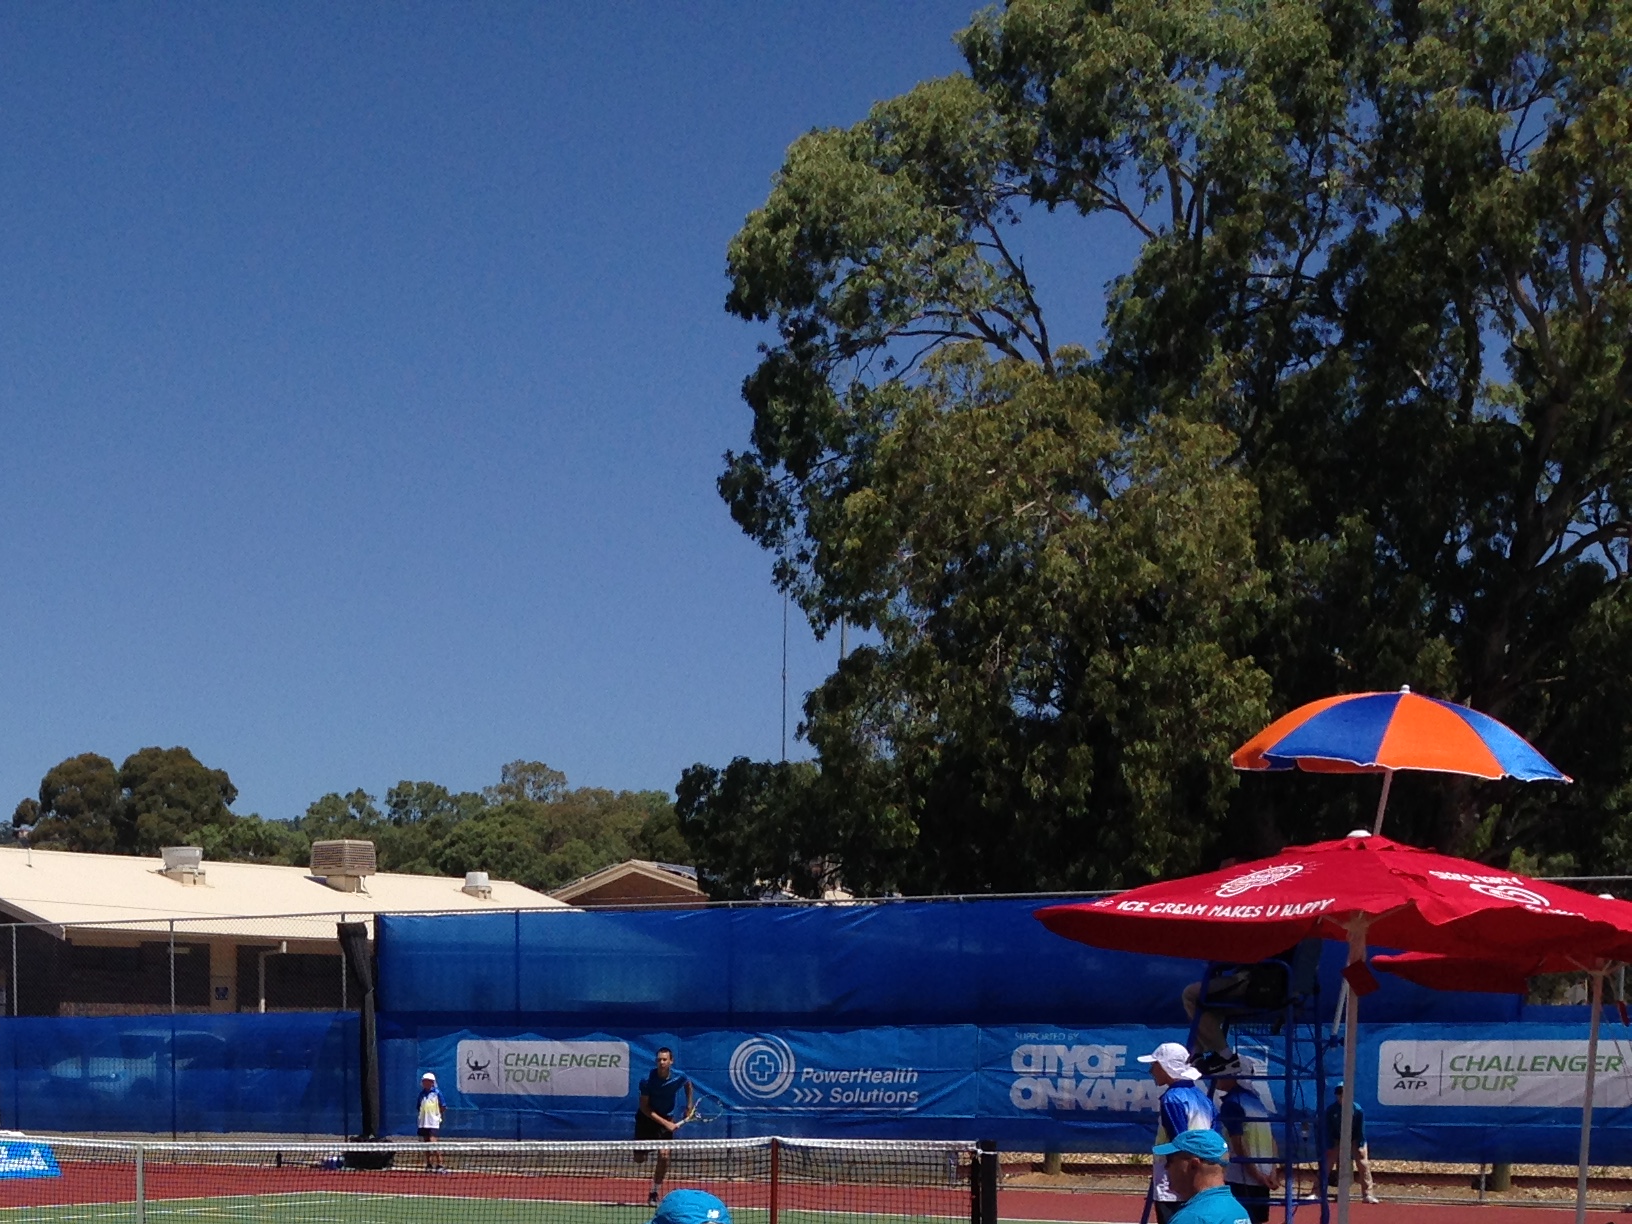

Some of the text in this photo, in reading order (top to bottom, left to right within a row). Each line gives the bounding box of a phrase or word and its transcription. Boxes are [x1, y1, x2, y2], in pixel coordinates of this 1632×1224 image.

[1117, 900, 1150, 913] ICE
[1149, 902, 1208, 916] CREAM
[1208, 904, 1261, 918] MAKES
[1267, 904, 1279, 917] U
[1283, 898, 1336, 917] HAPPY
[504, 1053, 622, 1068] CHALLENGER
[1448, 1055, 1624, 1072] CHALLENGER
[467, 1072, 490, 1081] ATP
[504, 1068, 552, 1083] TOUR
[801, 1067, 919, 1084] PowerHealth
[1449, 1075, 1519, 1092] TOUR
[1393, 1080, 1428, 1090] ATP
[829, 1087, 920, 1104] Solutions
